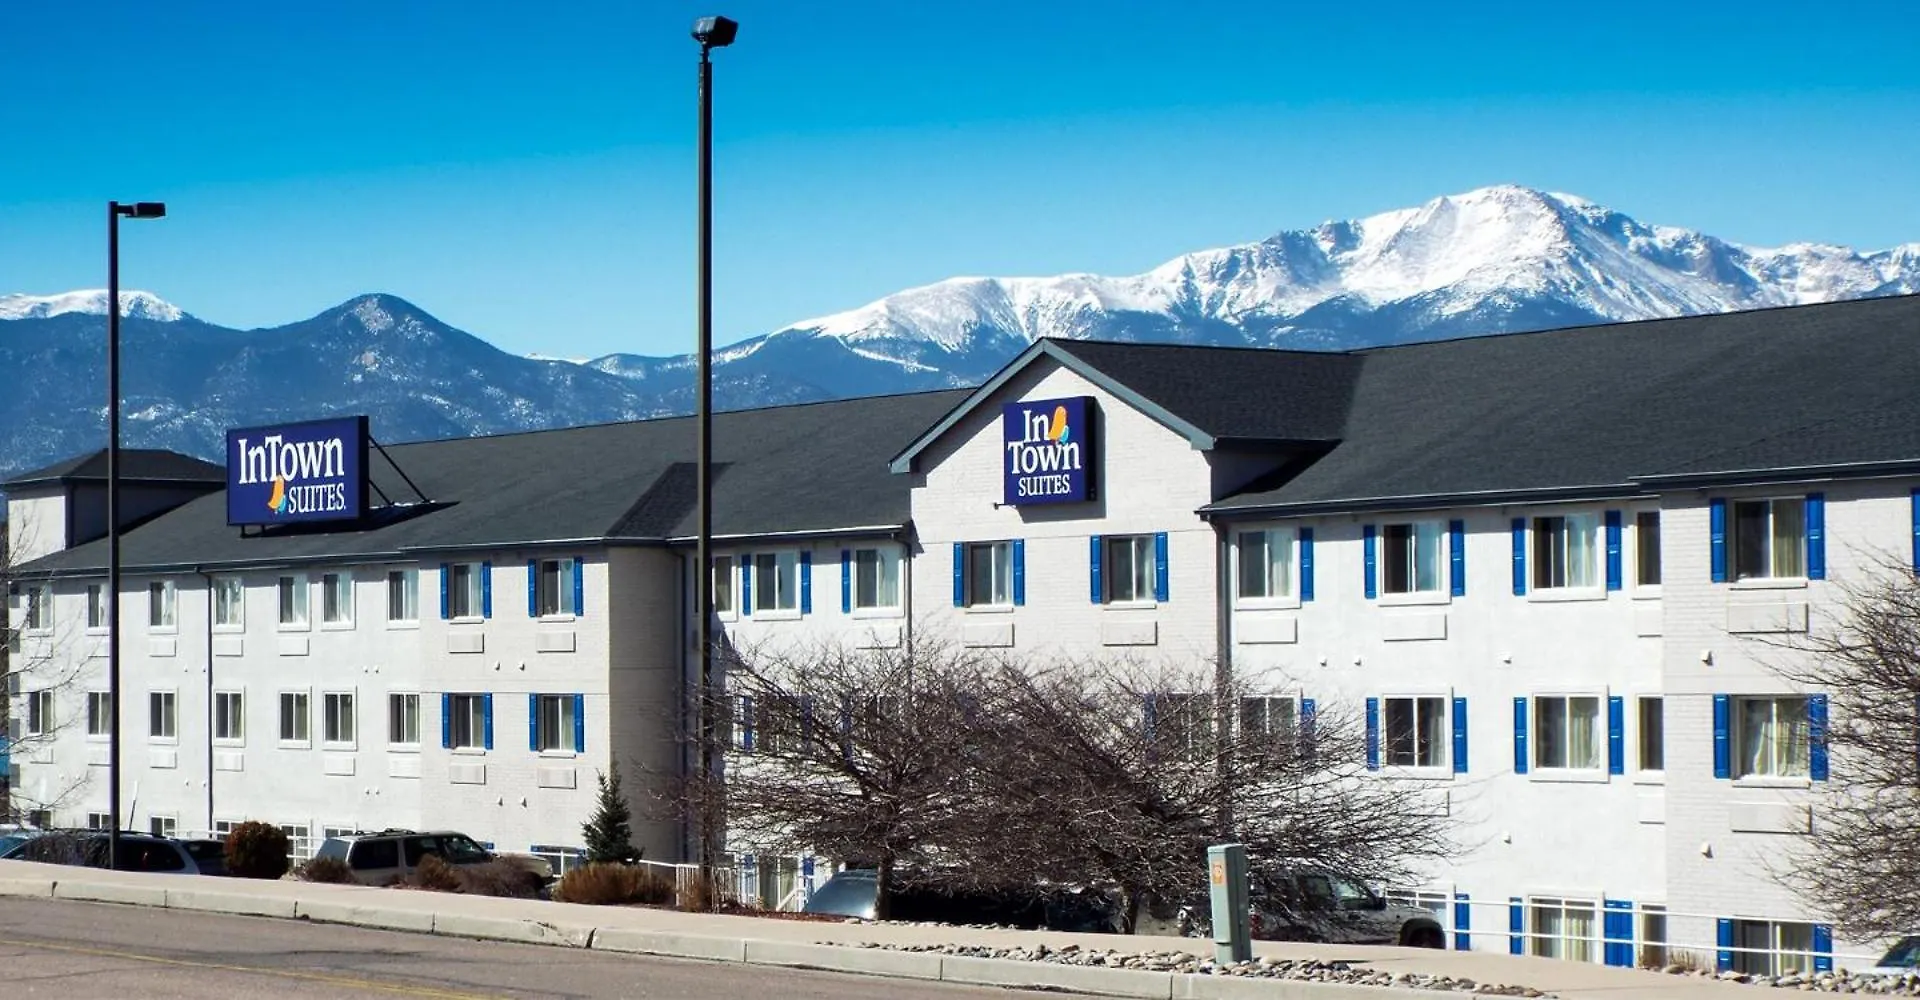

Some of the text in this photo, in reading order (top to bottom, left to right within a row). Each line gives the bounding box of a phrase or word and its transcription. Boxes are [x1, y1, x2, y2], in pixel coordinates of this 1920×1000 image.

[1023, 410, 1050, 442] In
[238, 434, 344, 484] InTown
[1008, 441, 1081, 474] Town
